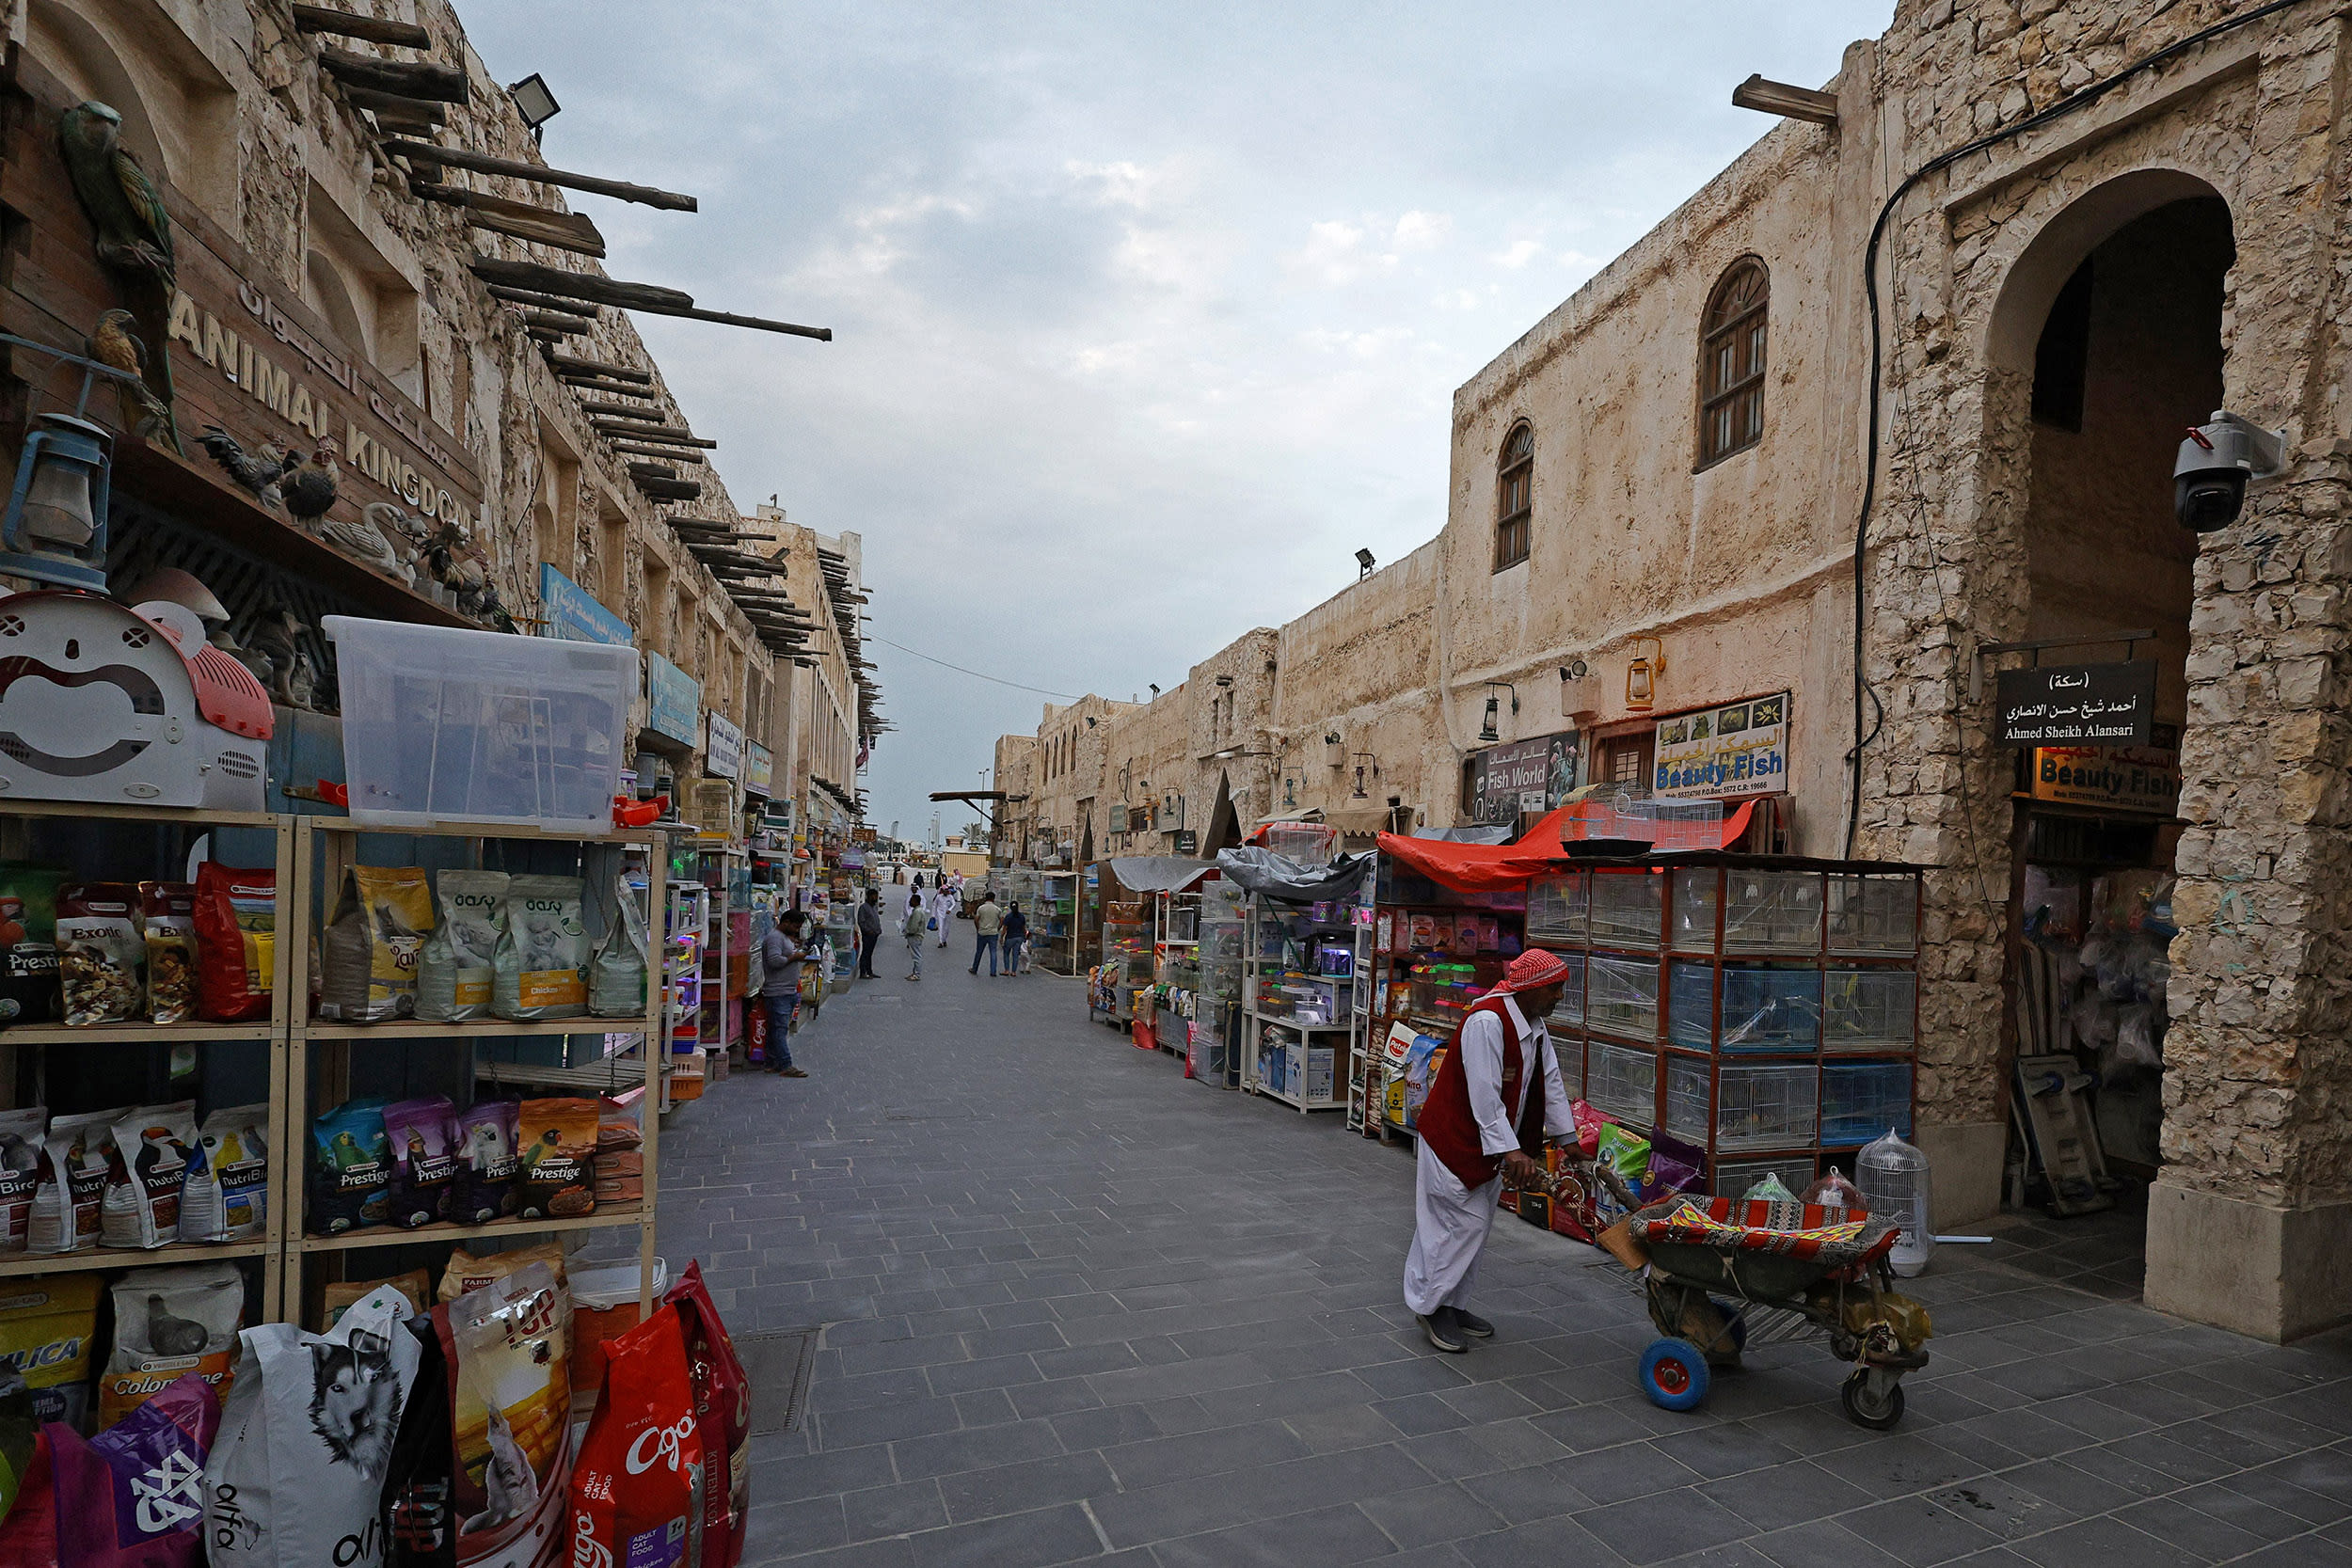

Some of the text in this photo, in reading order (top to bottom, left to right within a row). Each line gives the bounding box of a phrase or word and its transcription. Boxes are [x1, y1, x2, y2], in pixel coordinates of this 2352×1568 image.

[169, 289, 338, 453] ANIMAL
[2049, 705, 2078, 719] حسن
[2080, 698, 2105, 720] شيخ
[2107, 694, 2137, 713] أحمد
[2005, 723, 2134, 739] Ahmed Sheikh Alansari
[1487, 764, 1546, 790] Fish World
[1656, 750, 1782, 790] Beauty Fish
[2041, 758, 2175, 797] Beauty Fish
[8, 952, 60, 970] Presti
[340, 1169, 391, 1186] Prestige
[532, 1165, 580, 1180] Prestige
[707, 1449, 719, 1495] KITTEN
[584, 1470, 597, 1498] ADULT
[591, 1481, 603, 1499] CAT
[599, 1474, 613, 1499] FOOD
[631, 1540, 648, 1550] CAT
[632, 1529, 657, 1543] ADULT
[631, 1544, 654, 1557] FOOD
